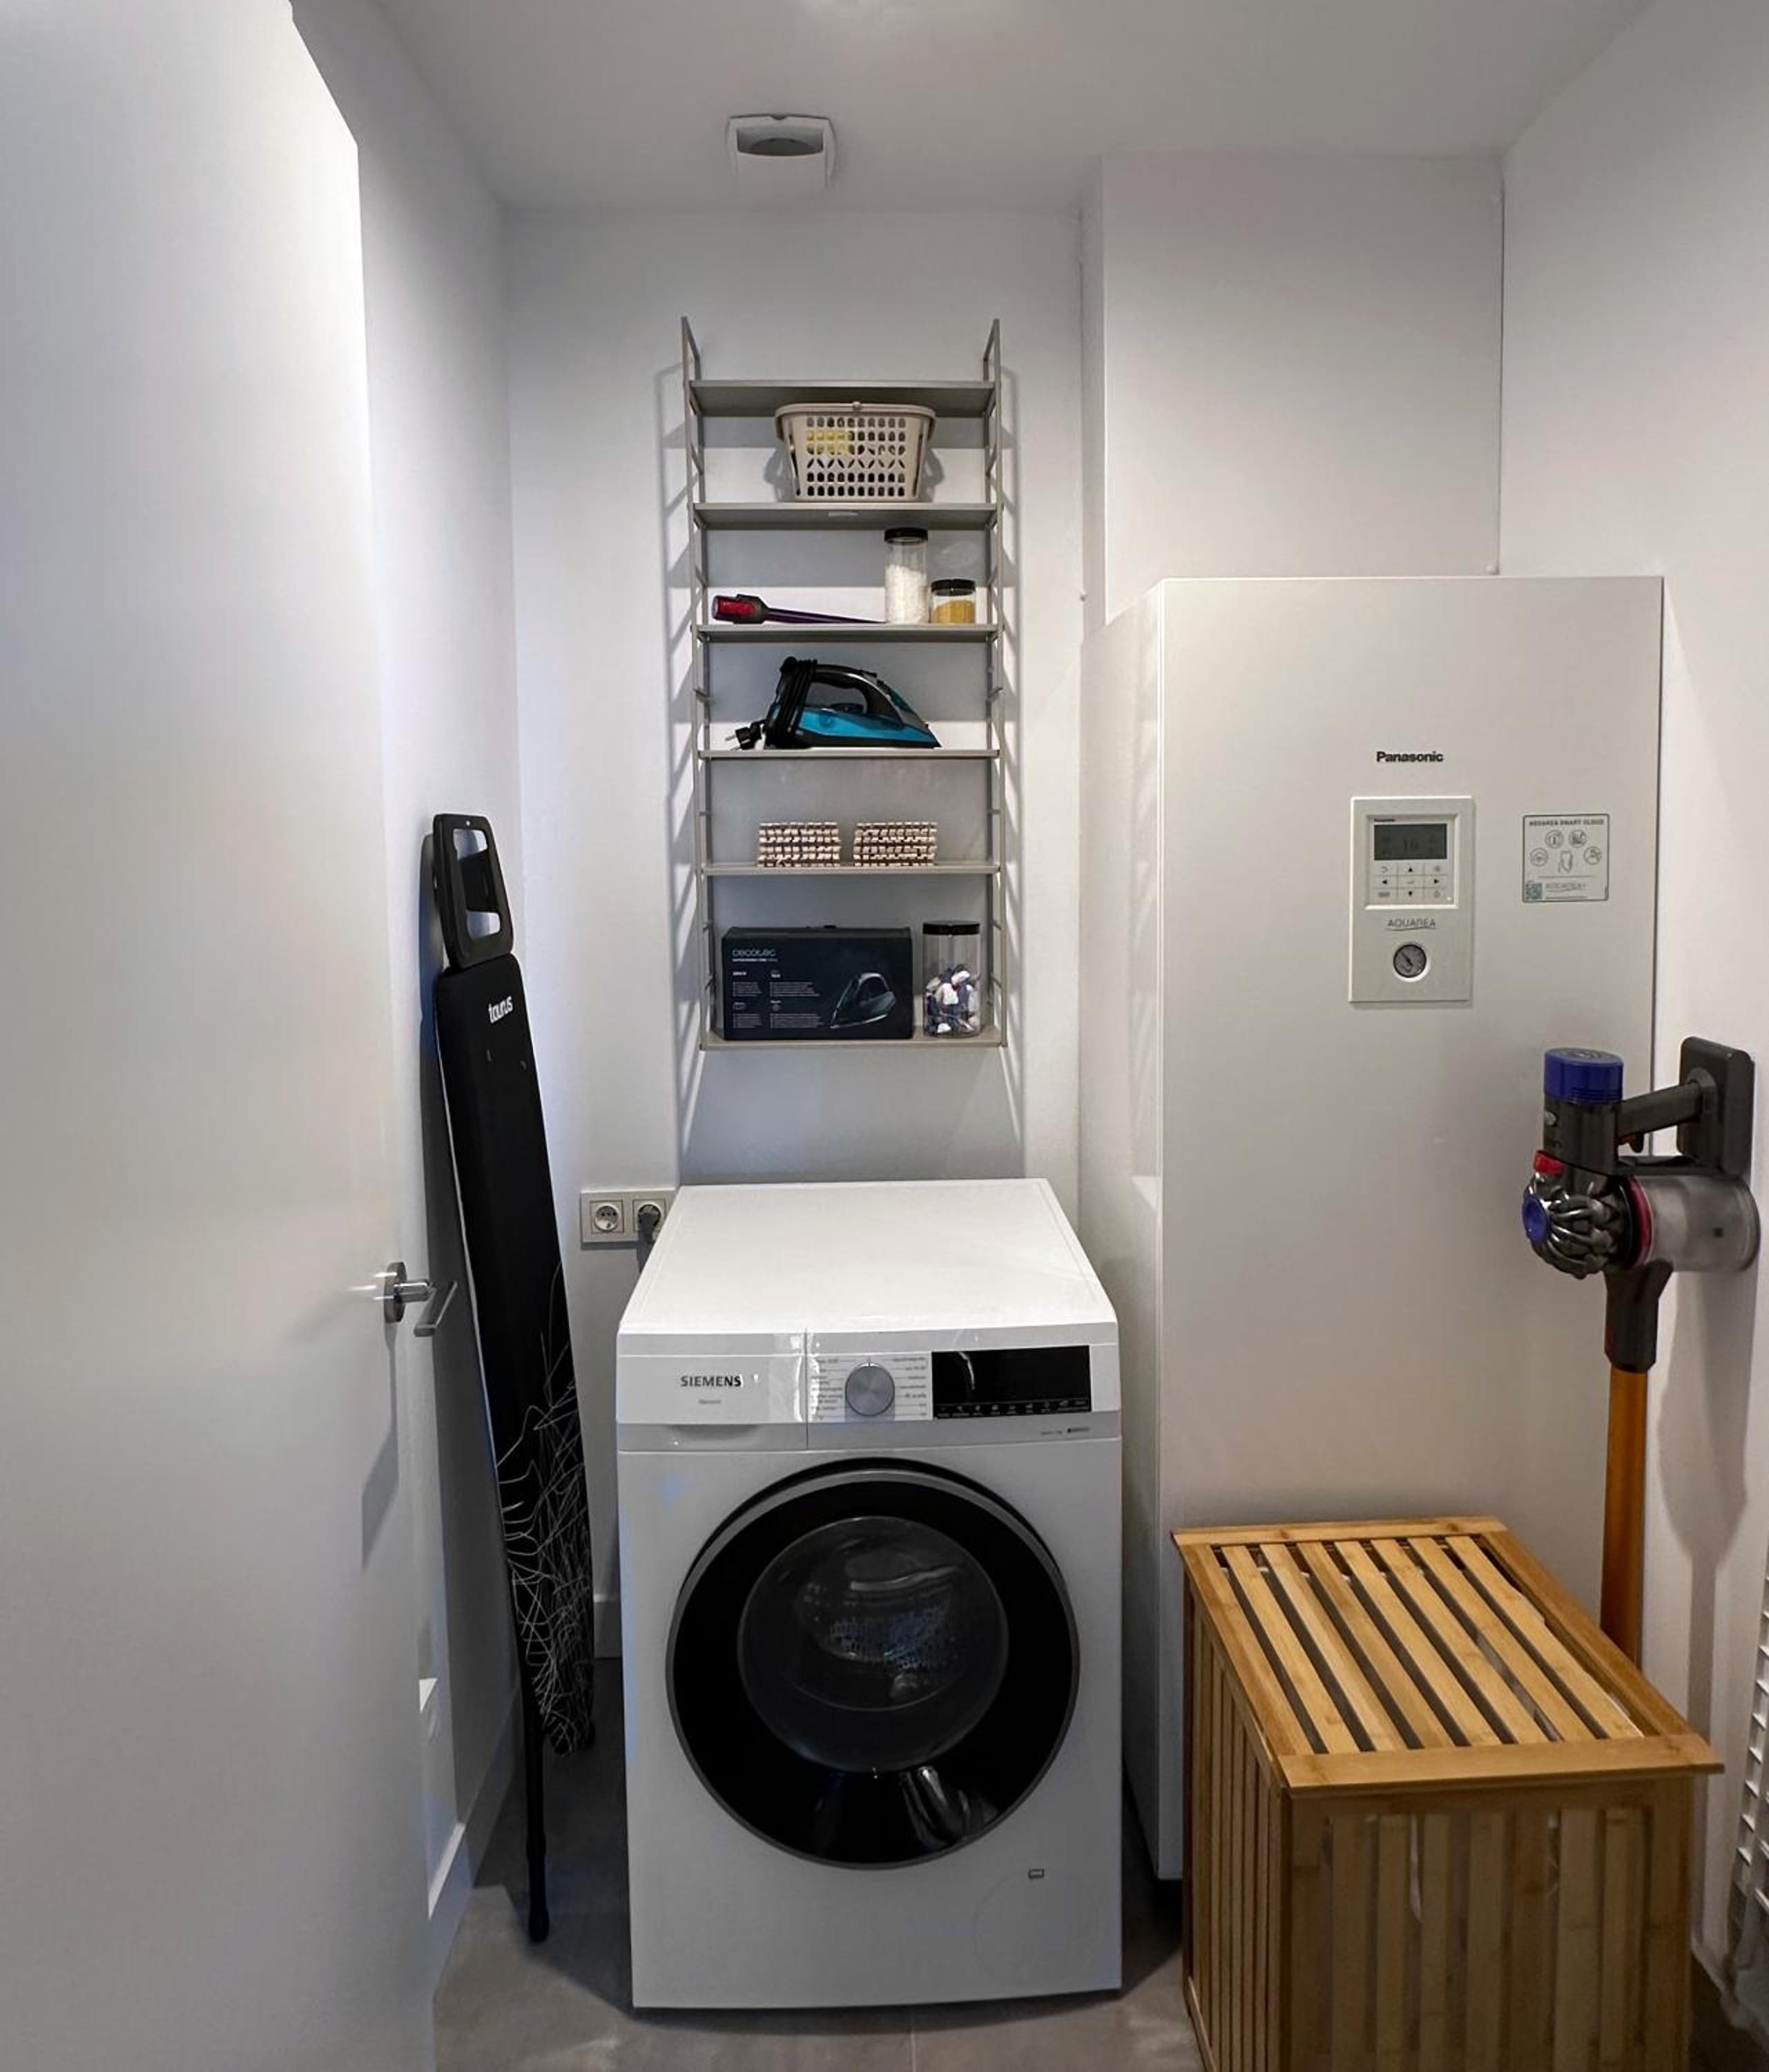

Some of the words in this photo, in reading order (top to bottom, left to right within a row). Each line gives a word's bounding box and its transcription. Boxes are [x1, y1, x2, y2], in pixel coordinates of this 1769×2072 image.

[1376, 751, 1444, 762] Panasonic
[488, 995, 513, 1024] taurus
[680, 1375, 742, 1387] SIEMENS
